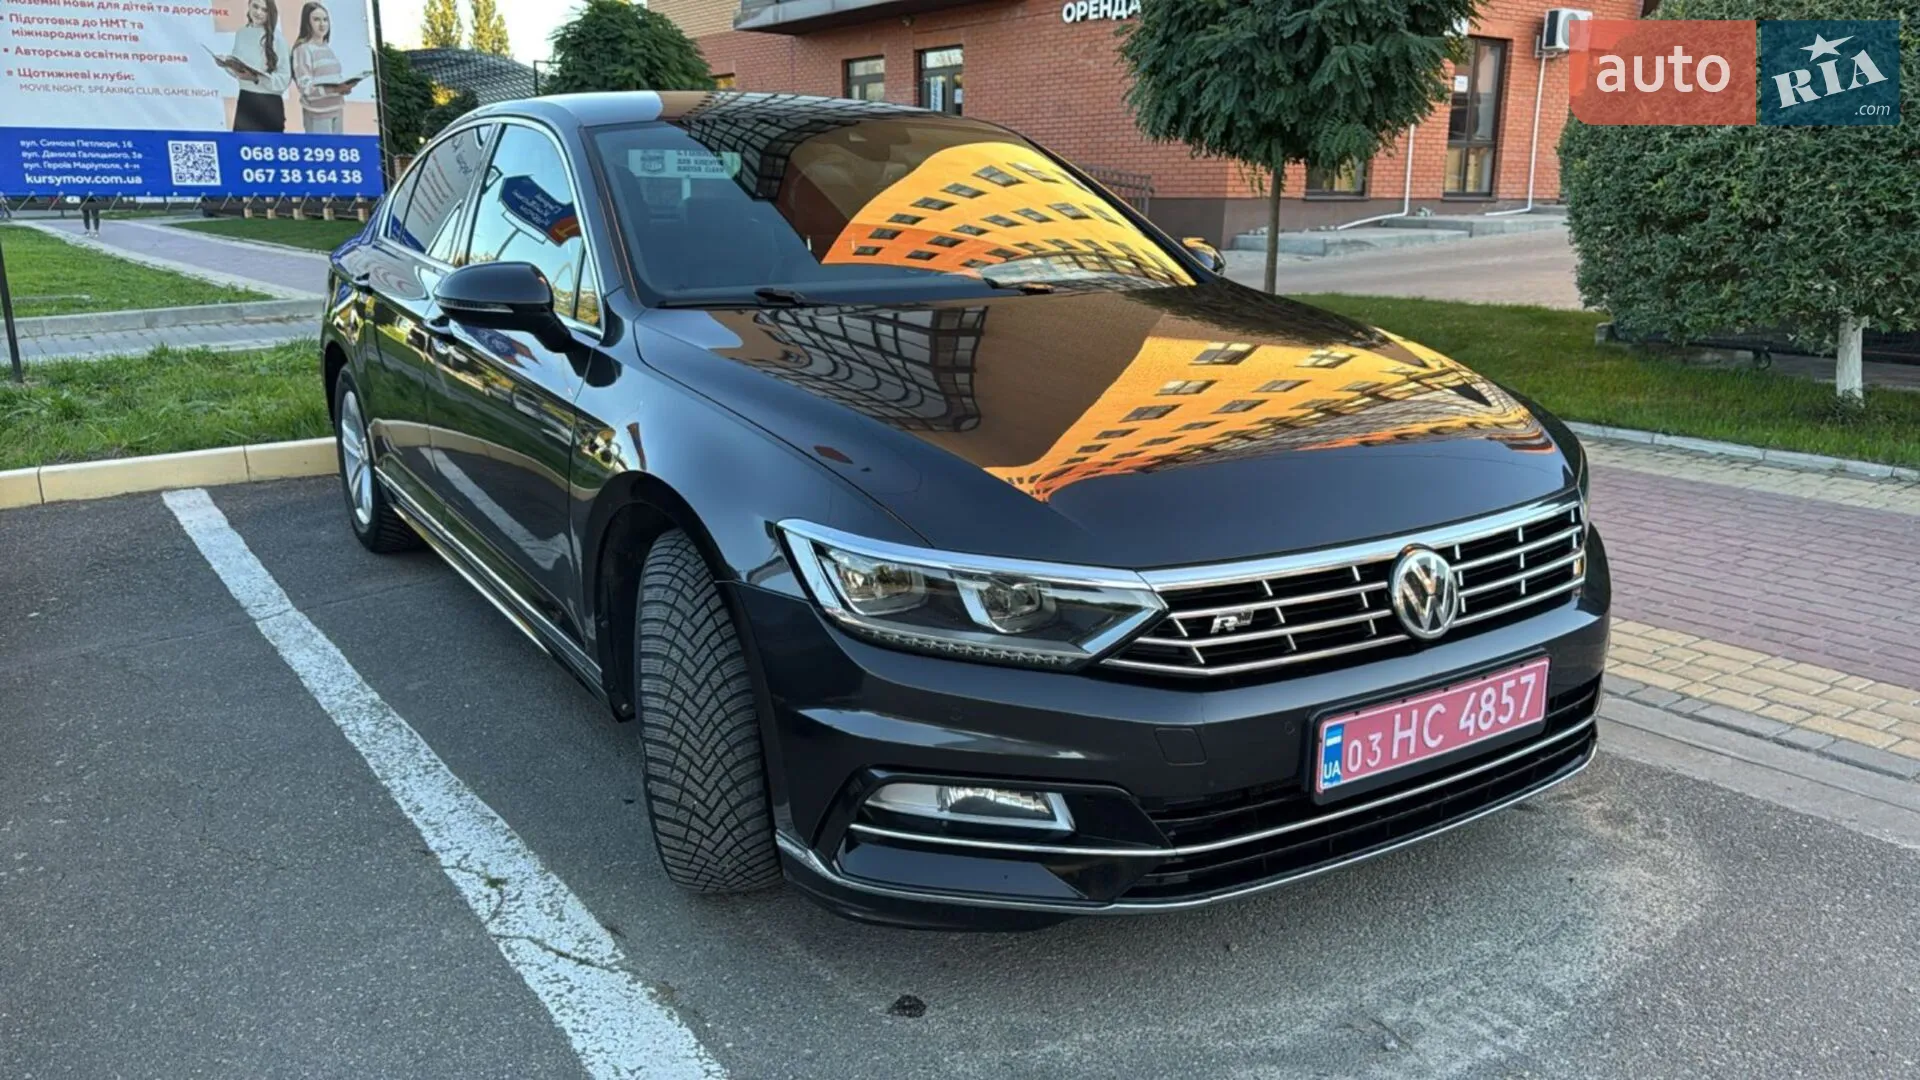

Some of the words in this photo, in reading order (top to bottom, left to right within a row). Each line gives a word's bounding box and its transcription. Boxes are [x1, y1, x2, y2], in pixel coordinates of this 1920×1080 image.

[63, 0, 95, 8] мови
[97, 1, 120, 10] для
[122, 1, 154, 11] дітей
[156, 5, 170, 13] та
[172, 6, 229, 17] дорослих
[1062, 0, 1141, 23] ОРЕНДА
[9, 13, 80, 26] Підготовка
[82, 19, 98, 28] до
[100, 18, 128, 29] НМТ
[130, 21, 144, 30] та
[12, 27, 95, 40] міжнародних
[97, 31, 139, 42] іспитів
[15, 46, 81, 58] Авторська
[83, 49, 130, 60] освітня
[131, 52, 189, 64] програма
[17, 68, 91, 80] Щотижневі
[93, 70, 135, 82] клуби:
[19, 83, 50, 92] MOVIE
[87, 85, 134, 95] SPEAKING
[163, 88, 191, 97] GAME
[192, 89, 220, 98] NIGHT
[40, 139, 76, 147] Симона
[42, 150, 77, 159] Данила
[240, 146, 274, 161] 068
[278, 147, 300, 161] 88
[303, 148, 335, 163] 299
[339, 148, 361, 163] 88
[25, 172, 143, 187] kursymov.com.ua
[243, 168, 275, 183] 067
[280, 169, 302, 183] 38
[306, 169, 337, 184] 164
[341, 170, 363, 184] 38
[1346, 731, 1384, 773] 03
[1391, 702, 1447, 760] HC
[1458, 672, 1538, 737] 4857
[1323, 759, 1342, 779] UA
